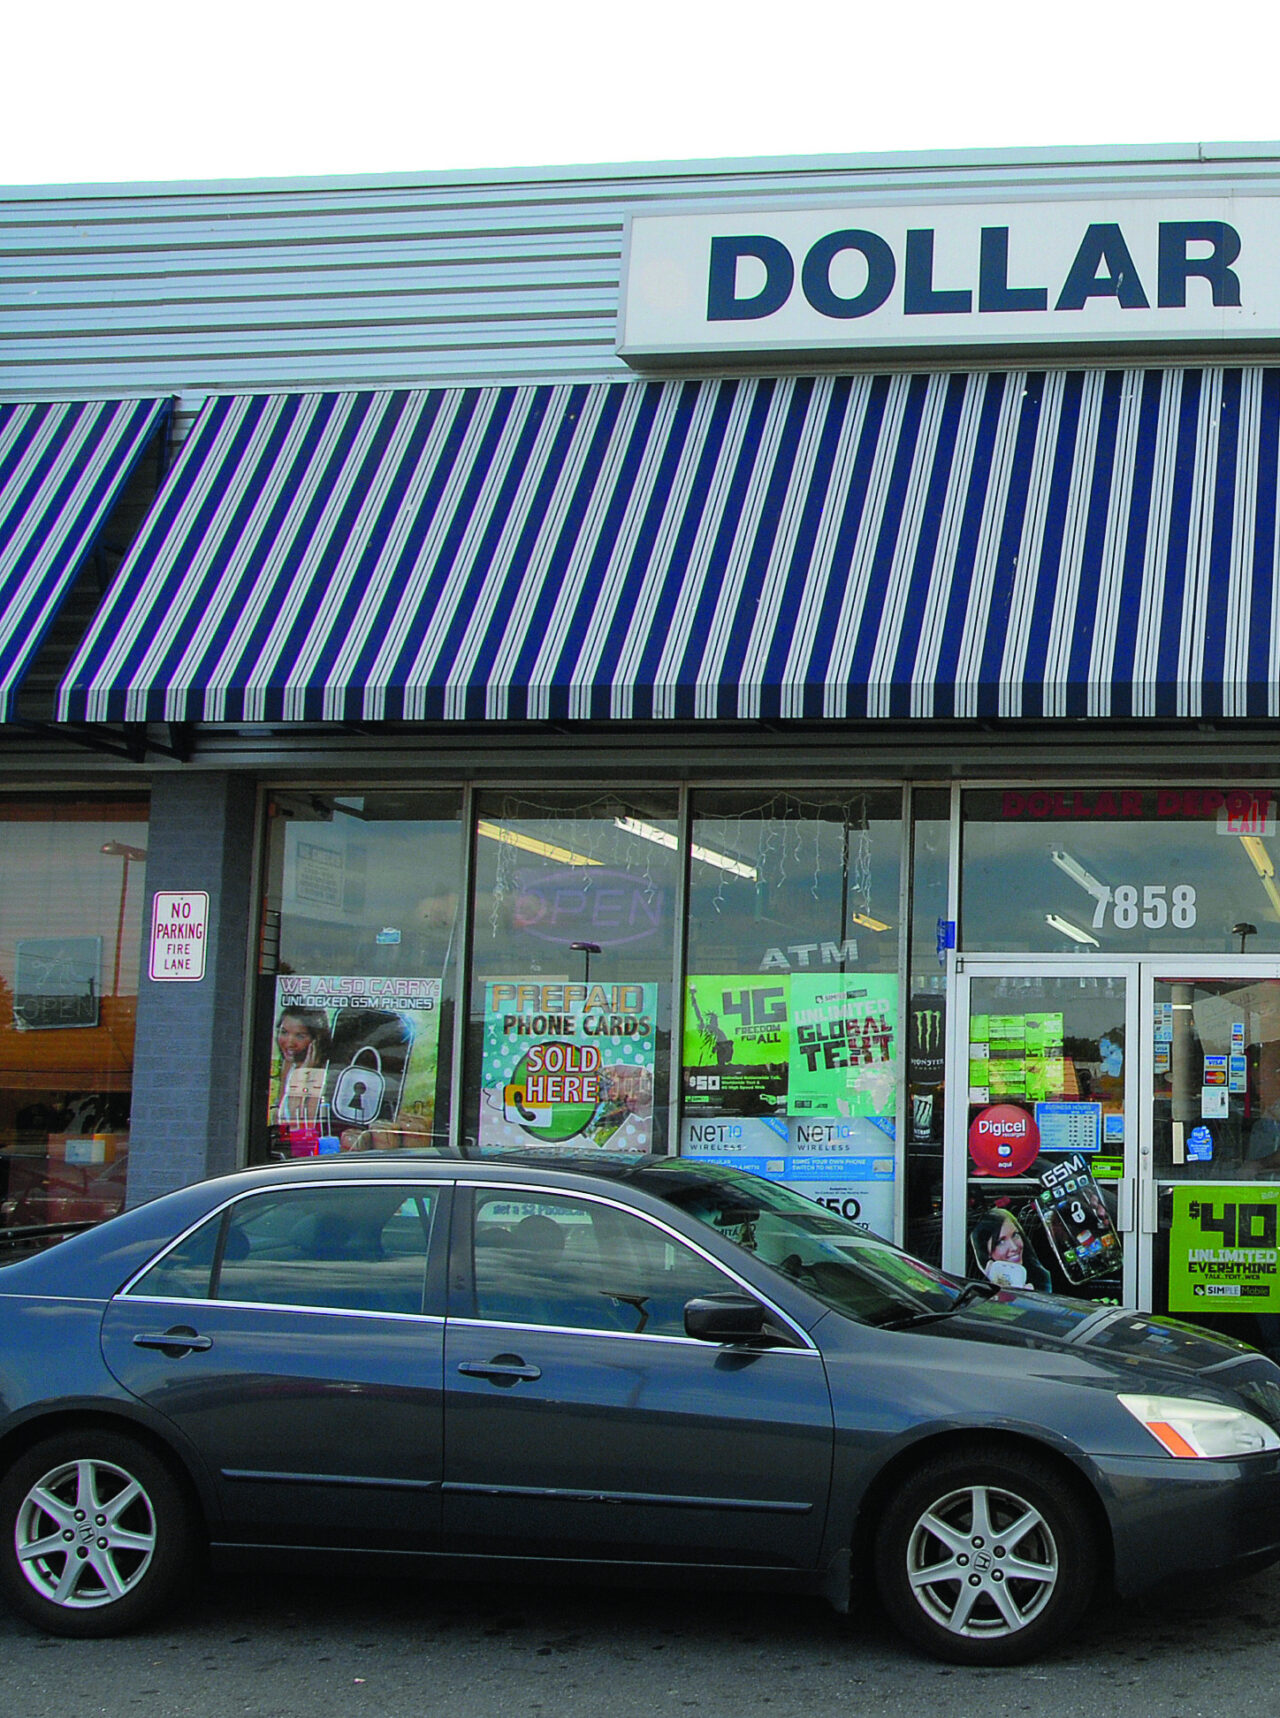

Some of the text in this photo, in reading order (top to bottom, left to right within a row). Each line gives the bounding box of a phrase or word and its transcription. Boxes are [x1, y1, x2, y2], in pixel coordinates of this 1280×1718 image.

[706, 220, 1242, 322] DOLLAR
[1002, 789, 1273, 818] DOLLAR DEPOT
[1226, 801, 1268, 834] EXIT
[171, 902, 192, 919] NO
[515, 889, 664, 928] OPEN
[1091, 884, 1197, 930] 7858
[156, 923, 203, 940] PARKING
[166, 943, 191, 955] FIRE
[759, 938, 860, 972] ATM
[164, 958, 191, 970] LANE
[279, 977, 312, 993] WE
[315, 978, 365, 994] ALSO
[280, 993, 434, 1011] UNLOCKED GSM PHONES
[491, 983, 644, 1014] PREPAID
[721, 986, 788, 1027] 4G
[794, 998, 891, 1025] UNLIMITED
[503, 1015, 652, 1037] PHONE CARDS
[735, 1024, 782, 1036] FREEDOM
[796, 1014, 893, 1044] GLOBAL
[756, 1032, 782, 1045] ALL
[526, 1044, 600, 1073] SOLD
[525, 1075, 600, 1104] HERE
[689, 1075, 721, 1091] $50
[977, 1118, 1026, 1137] Digicel
[1041, 1154, 1084, 1188] GSM
[1188, 1200, 1278, 1249] $40
[1188, 1248, 1278, 1263] UNLIMITED
[1188, 1262, 1277, 1274] EVERYTHING
[1207, 1285, 1269, 1296] SIMPLE Mobile
